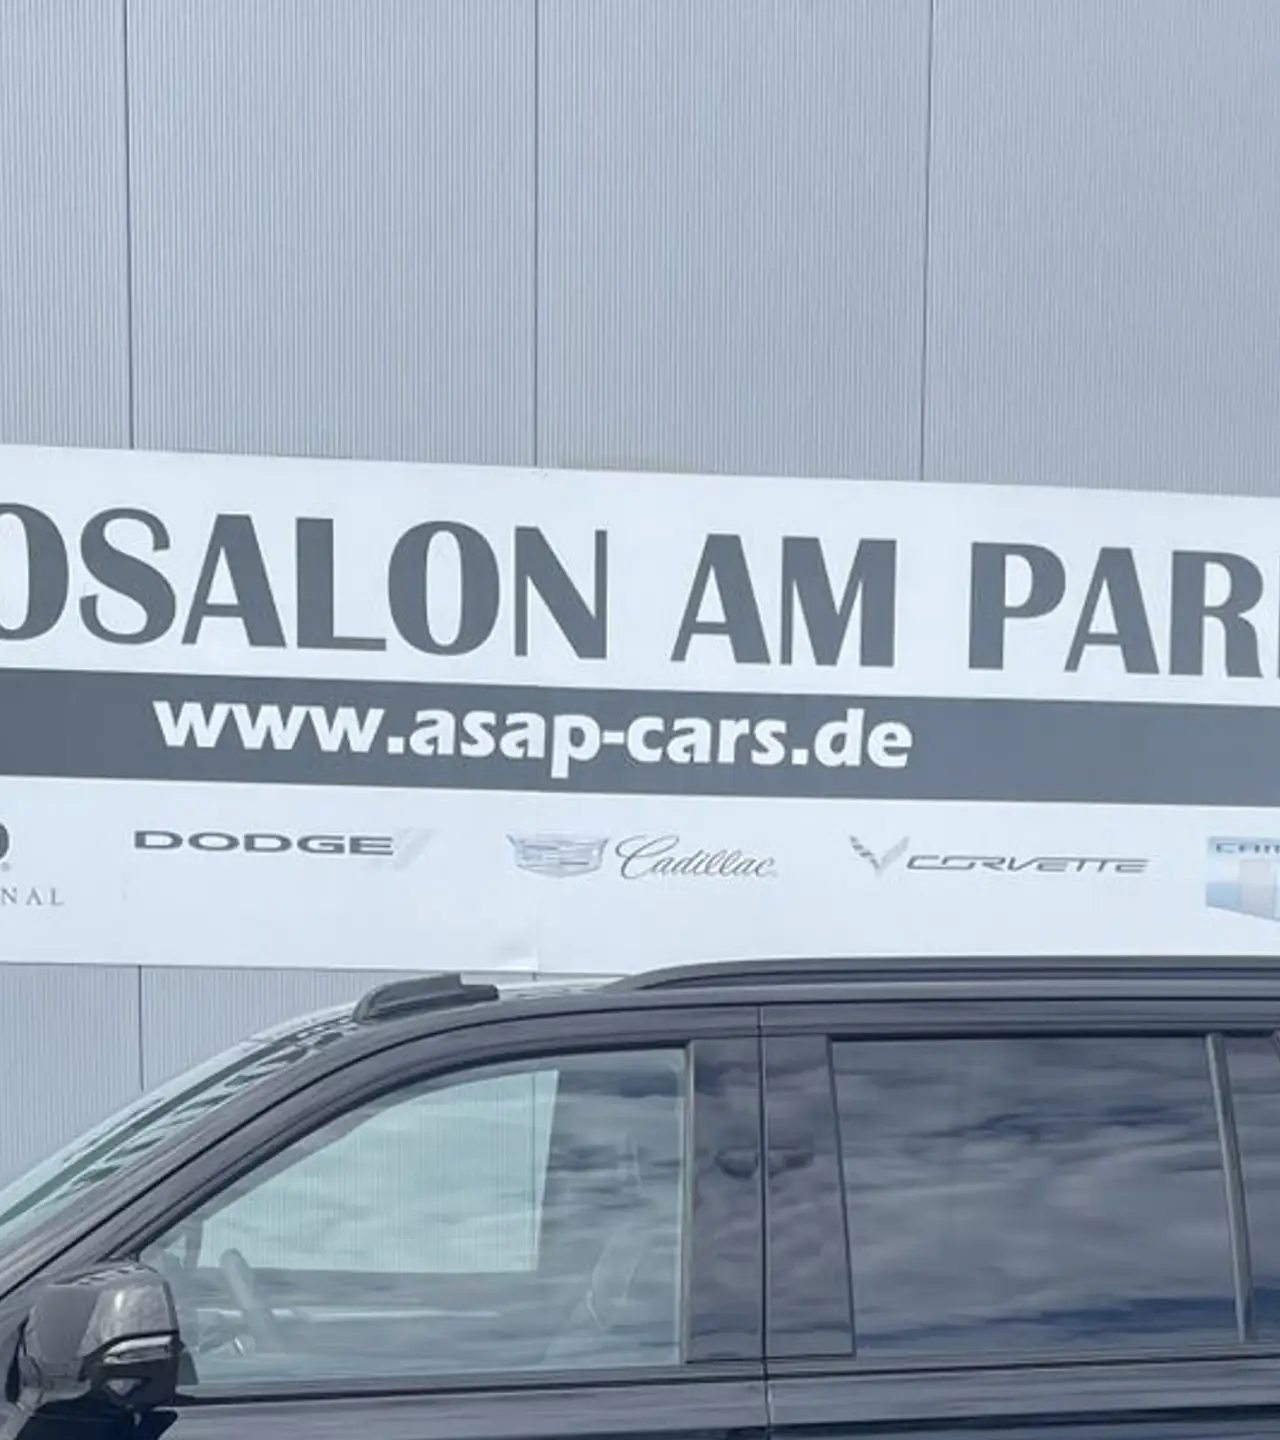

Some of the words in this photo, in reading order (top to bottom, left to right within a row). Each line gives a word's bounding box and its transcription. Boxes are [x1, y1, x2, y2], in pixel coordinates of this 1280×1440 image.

[669, 533, 898, 667] AM
[153, 699, 914, 778] www.asap-cars.de
[133, 829, 395, 856] DODGE
[614, 833, 777, 880] Cadillac
[906, 854, 1150, 873] CORVETTE
